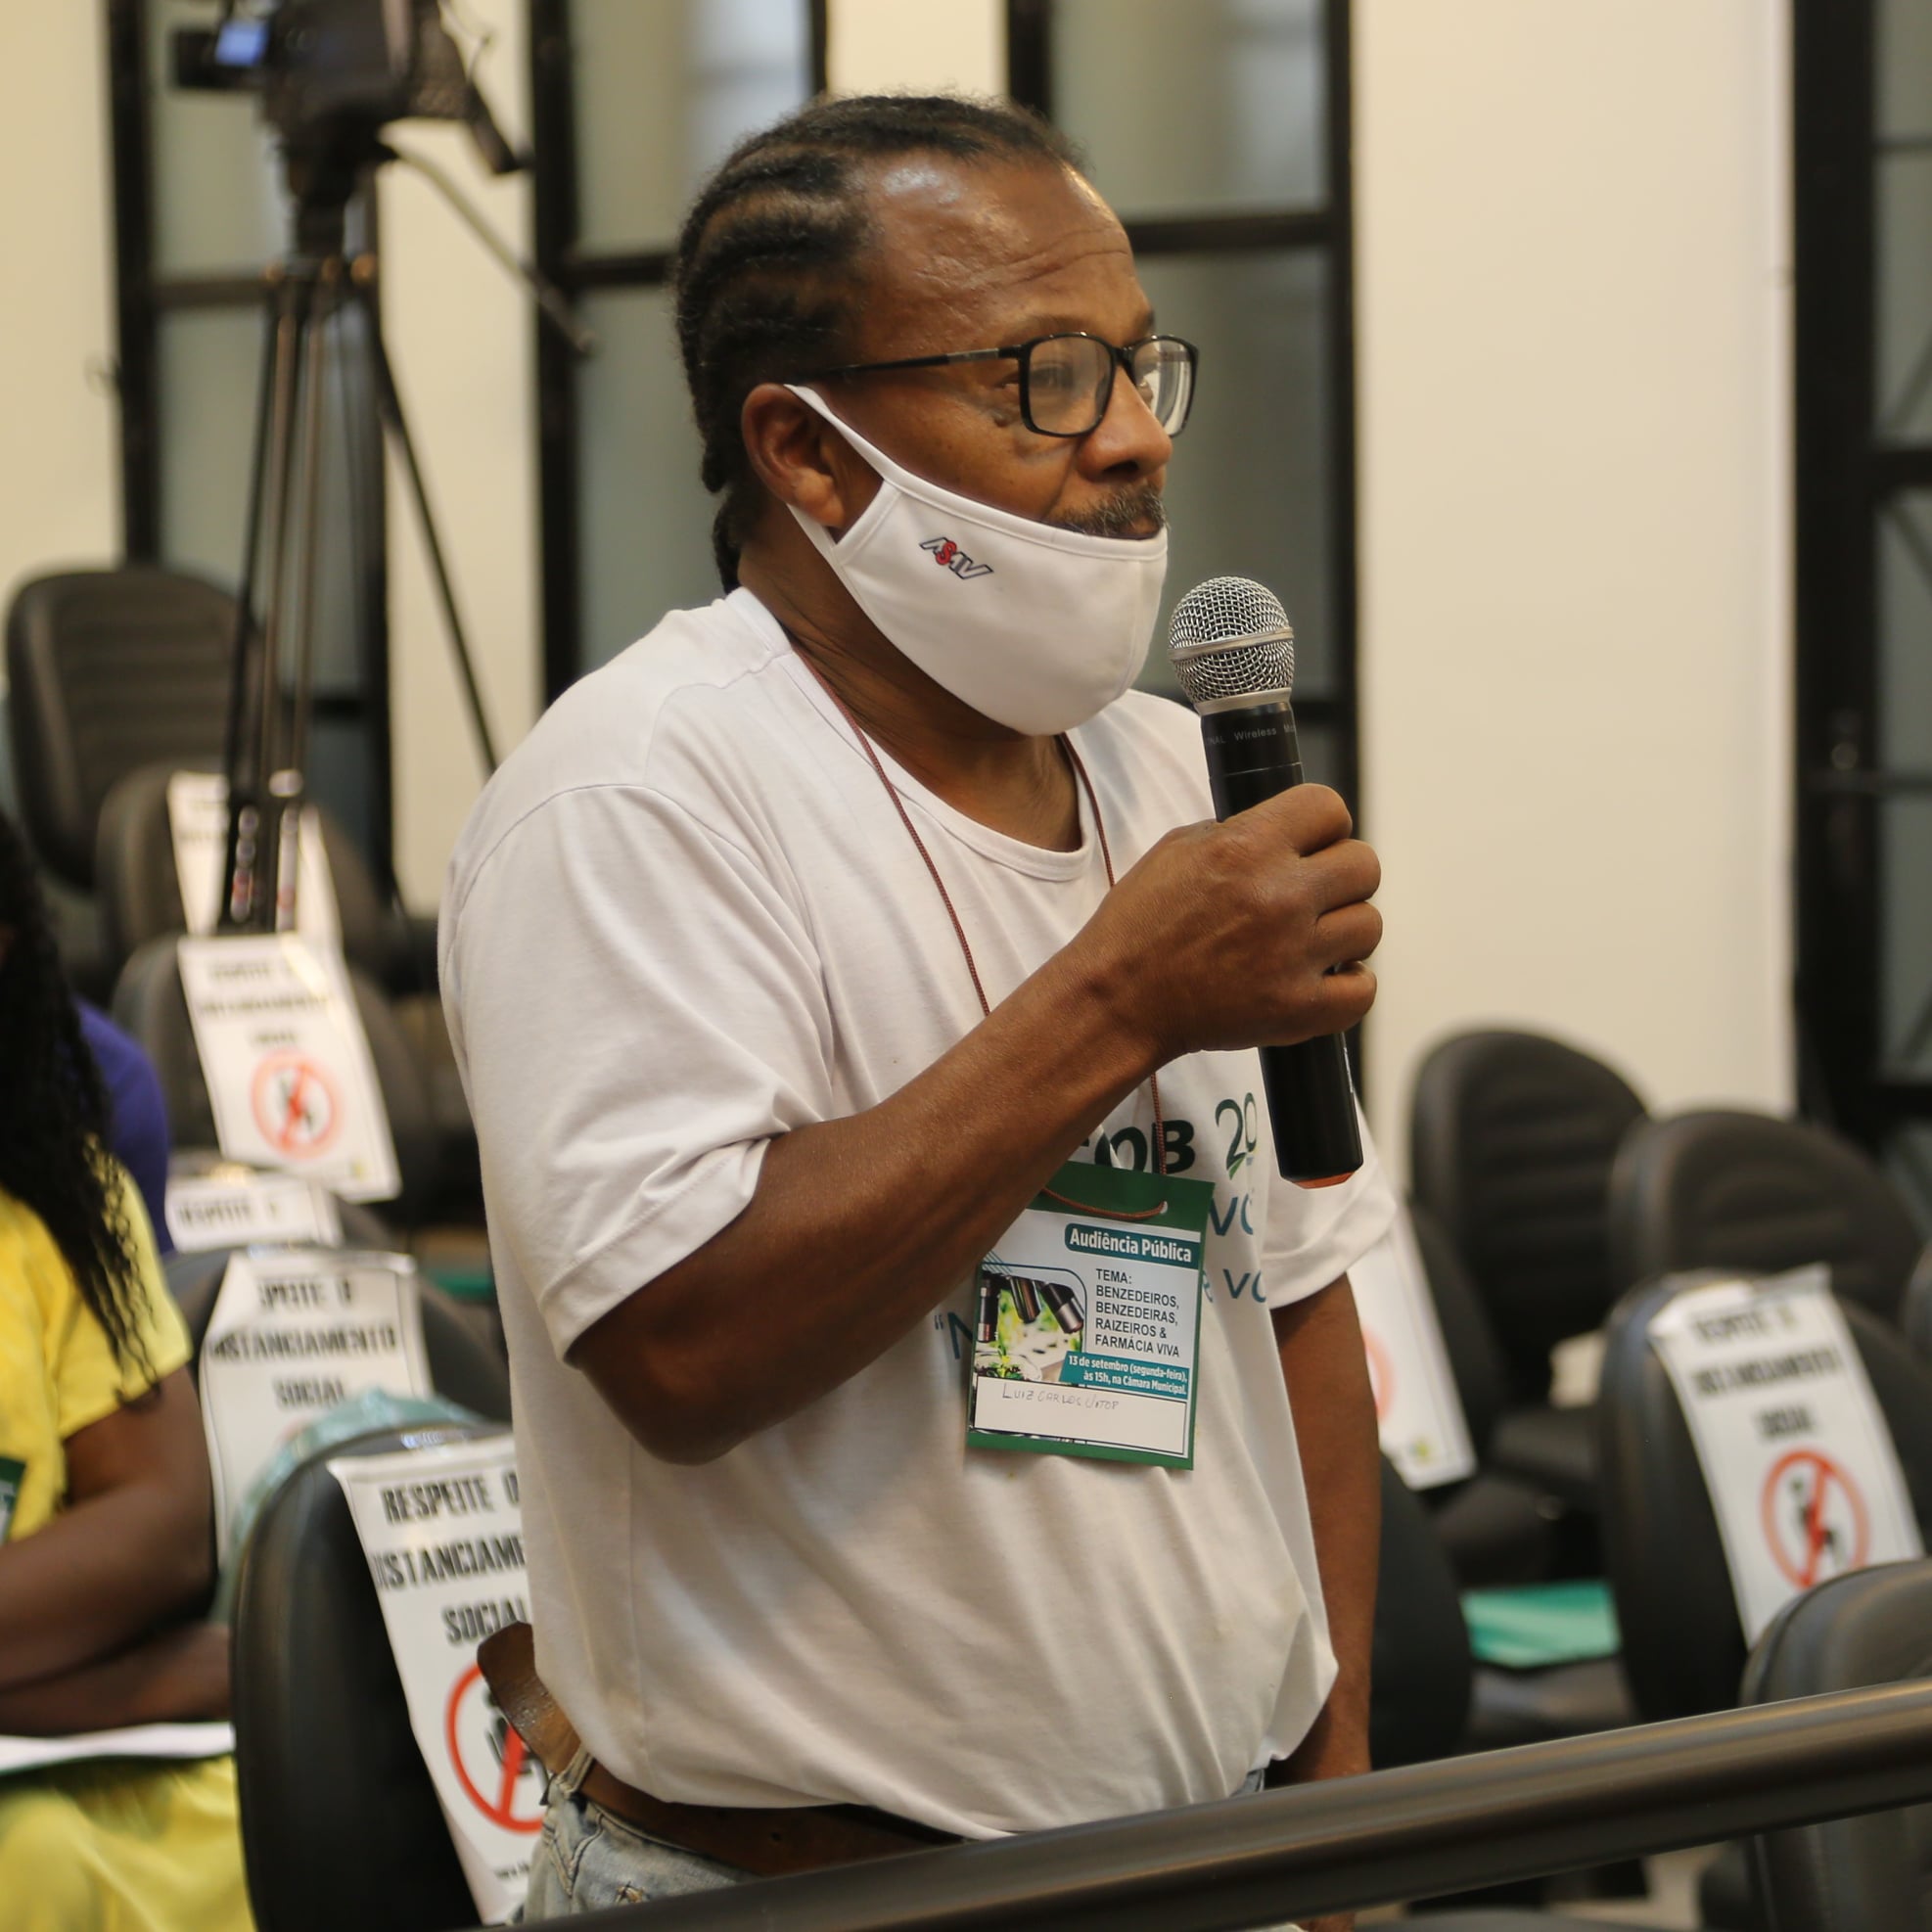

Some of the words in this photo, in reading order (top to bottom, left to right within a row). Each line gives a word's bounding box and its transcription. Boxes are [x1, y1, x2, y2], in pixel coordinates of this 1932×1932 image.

[1233, 726, 1277, 741] Wireless
[1069, 1227, 1139, 1255] Audiência
[1141, 1238, 1192, 1263] Pública
[1095, 1268, 1132, 1285] TEMA:
[1095, 1284, 1179, 1311] BENZEDEIROS,
[1095, 1301, 1178, 1326] BENZEDEIRAS,
[1095, 1317, 1157, 1338] RAIZEIROS
[1159, 1326, 1168, 1339] &
[1095, 1333, 1154, 1354] FARMÁCIA
[1157, 1342, 1180, 1357] VIVA
[1068, 1355, 1078, 1366] 13
[1079, 1356, 1090, 1367] de
[1091, 1357, 1129, 1373] setembro
[1129, 1362, 1188, 1383] (segunda-feira),
[1082, 1369, 1094, 1381] às
[1095, 1371, 1111, 1386] 15h,
[1112, 1374, 1123, 1385] na
[1123, 1375, 1151, 1390] Câmara
[1151, 1380, 1187, 1396] Municipal.
[381, 1474, 494, 1525] RESPEITE
